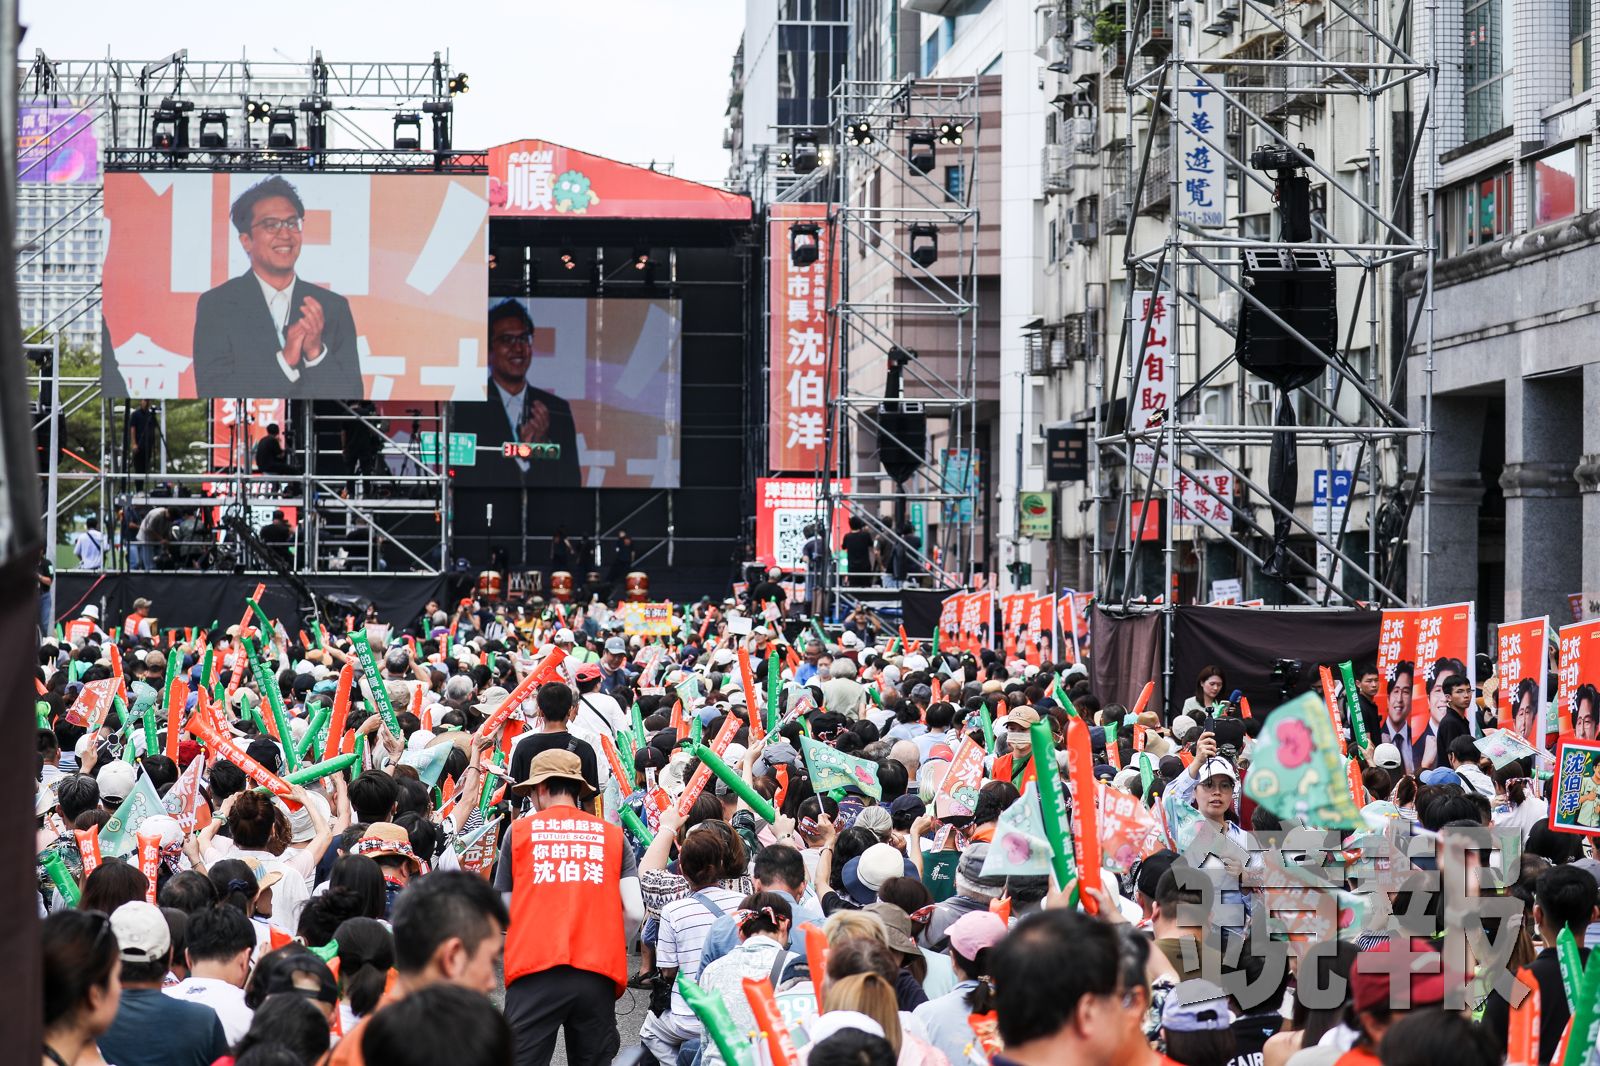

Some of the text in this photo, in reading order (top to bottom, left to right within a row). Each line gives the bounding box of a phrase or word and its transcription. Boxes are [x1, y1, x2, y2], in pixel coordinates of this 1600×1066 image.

[509, 150, 553, 163] SOON
[1185, 79, 1214, 207] 中華遊覽
[505, 163, 553, 211] 順
[786, 327, 825, 450] 沈伯洋
[1560, 752, 1585, 813] 沈伯洋
[532, 819, 604, 833] 台北順起來
[532, 844, 604, 861] 你的市長
[533, 861, 604, 885] 沈伯洋
